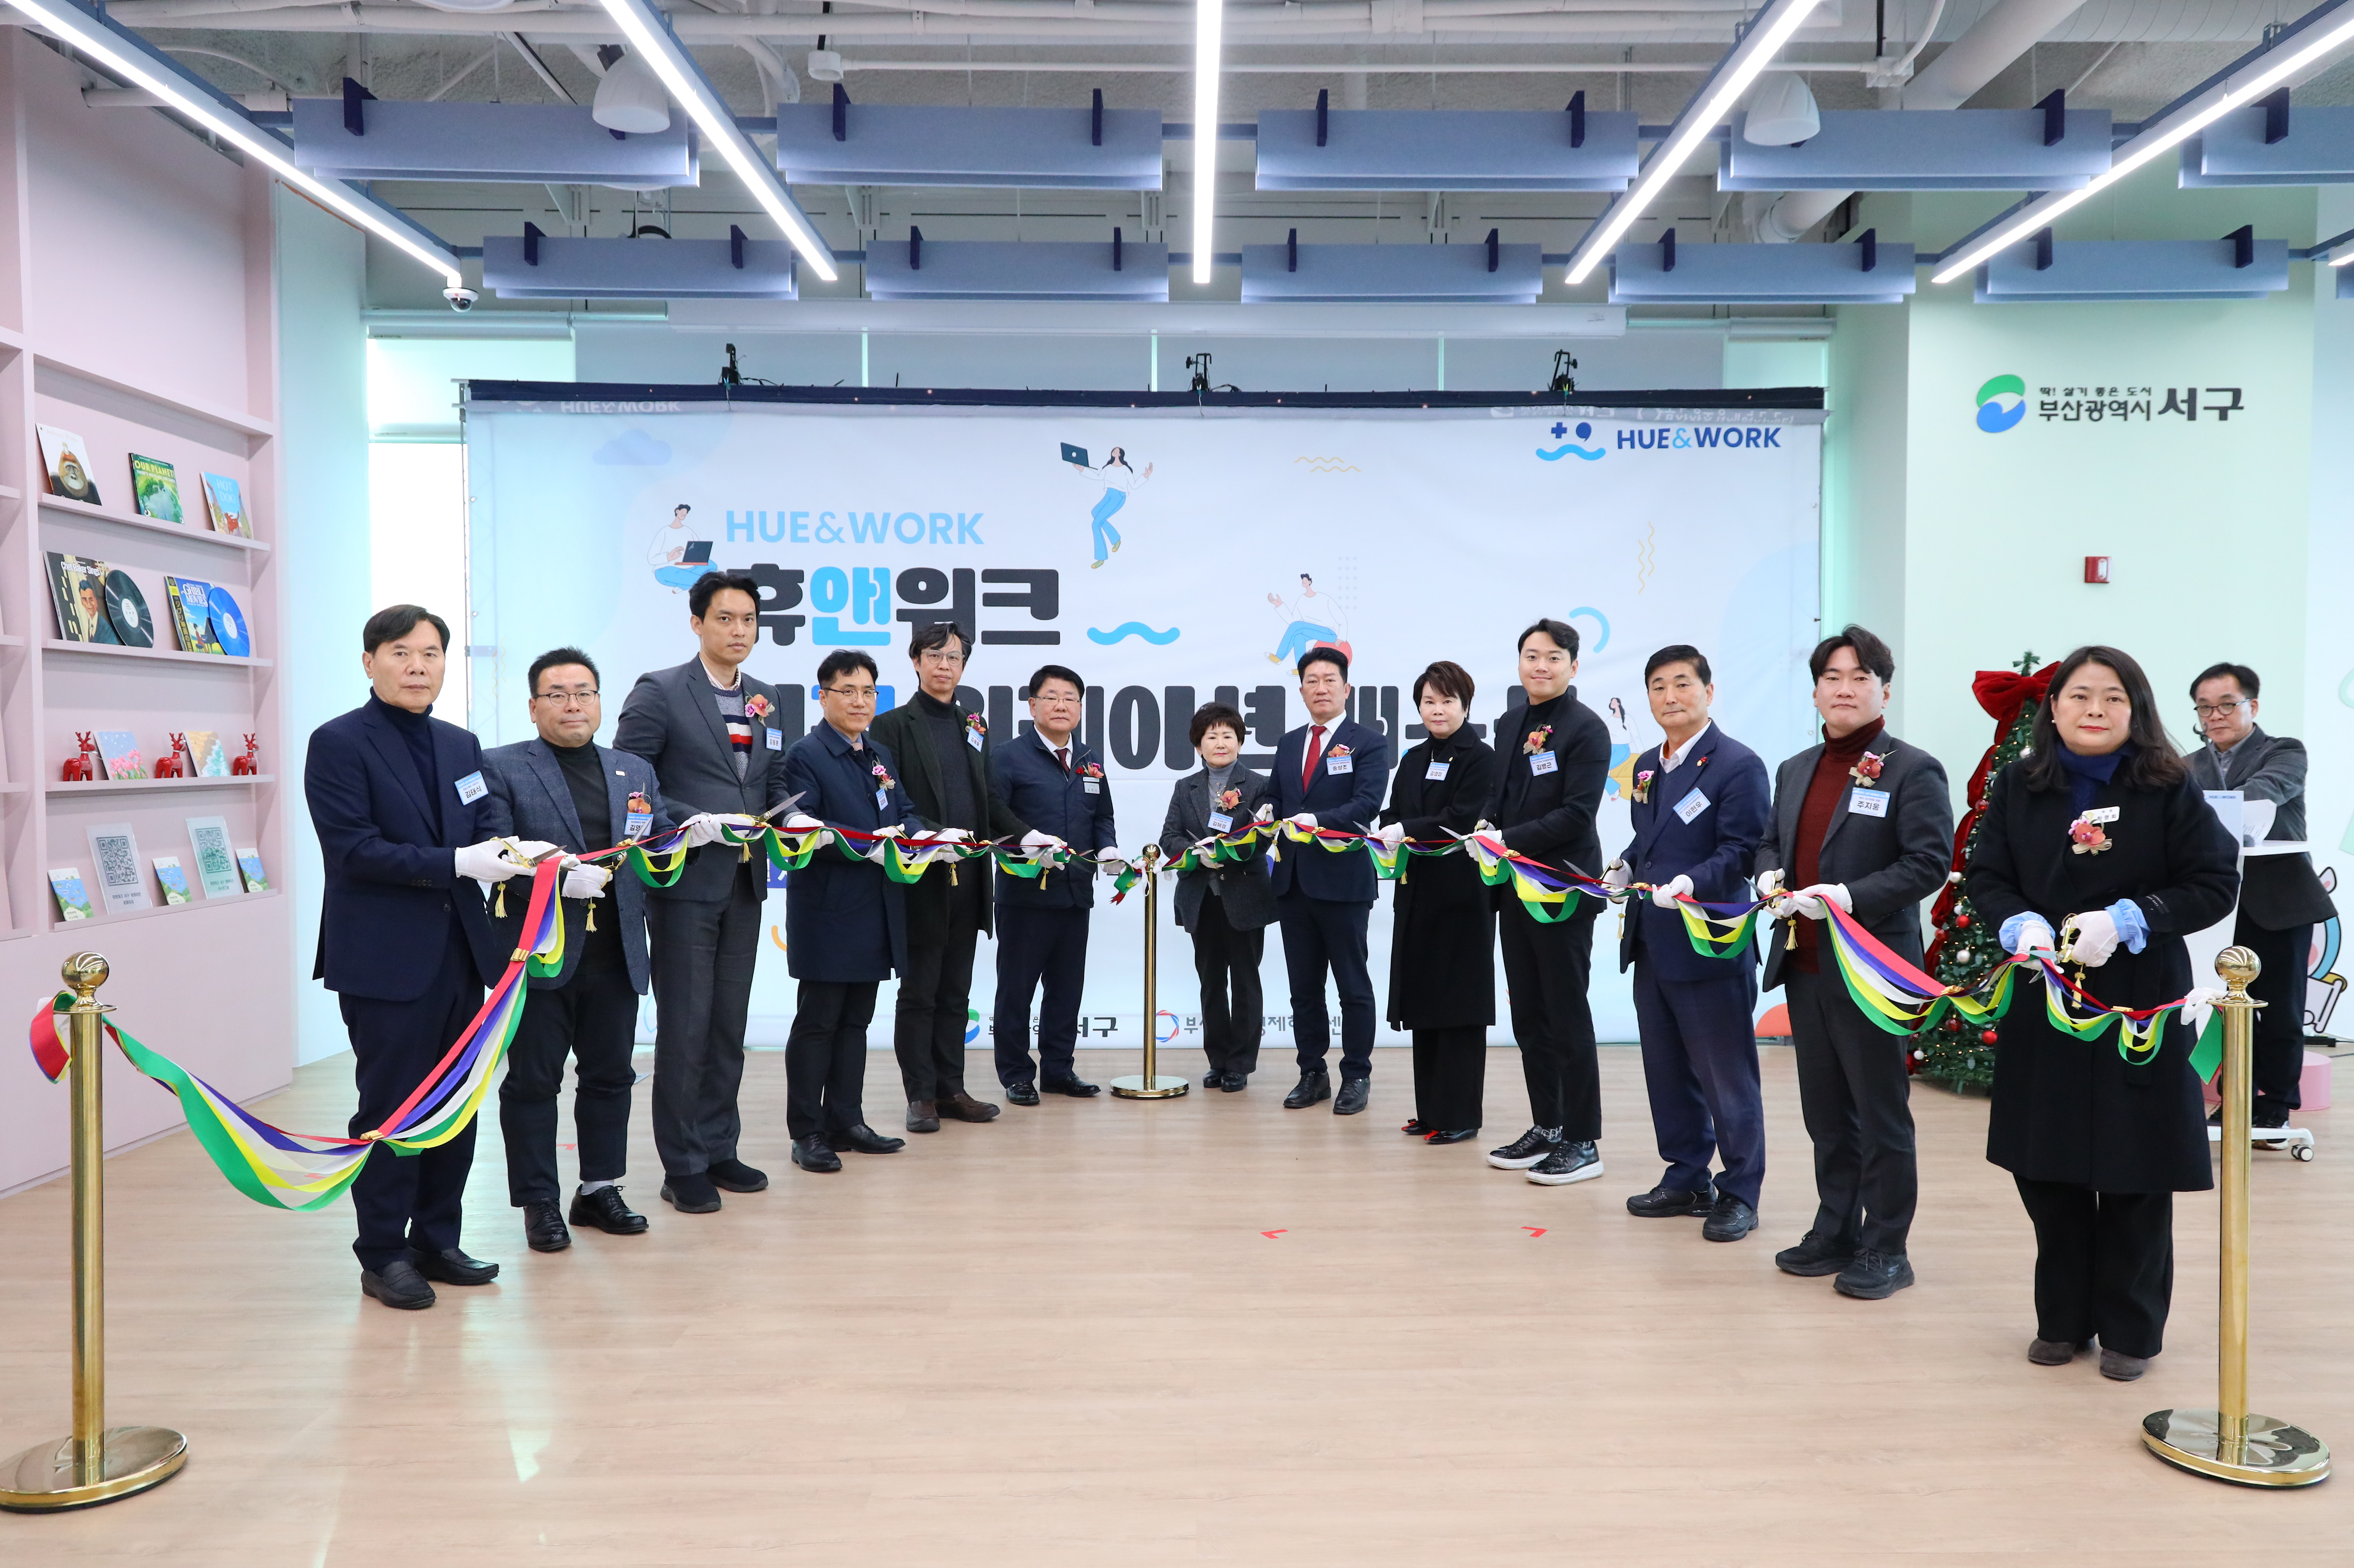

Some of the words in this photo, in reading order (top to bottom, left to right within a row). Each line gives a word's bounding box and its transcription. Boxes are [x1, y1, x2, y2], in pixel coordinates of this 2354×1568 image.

[2040, 387, 2056, 396] 딱!
[2063, 387, 2088, 396] 살기
[2095, 387, 2119, 396] 좋은
[2127, 387, 2152, 396] 도시
[2039, 400, 2151, 421] 부산광역시
[2158, 387, 2244, 421] 서구
[1617, 427, 1782, 449] HUE&WORK
[134, 460, 151, 471] OUR
[216, 479, 232, 492] HOT
[218, 490, 236, 504] DOG
[726, 510, 984, 545] HUE&WORK
[61, 561, 73, 571] Chet
[73, 564, 87, 573] Baker
[86, 566, 100, 577] Sings
[183, 584, 205, 596] GHIBLI
[181, 591, 208, 608] MOVIES
[726, 563, 1061, 646] 휴앤워크
[1536, 762, 1552, 771] 김병근
[465, 785, 482, 799] 김태식
[1685, 801, 1702, 817] 이현우
[1857, 801, 1880, 811] 주지웅
